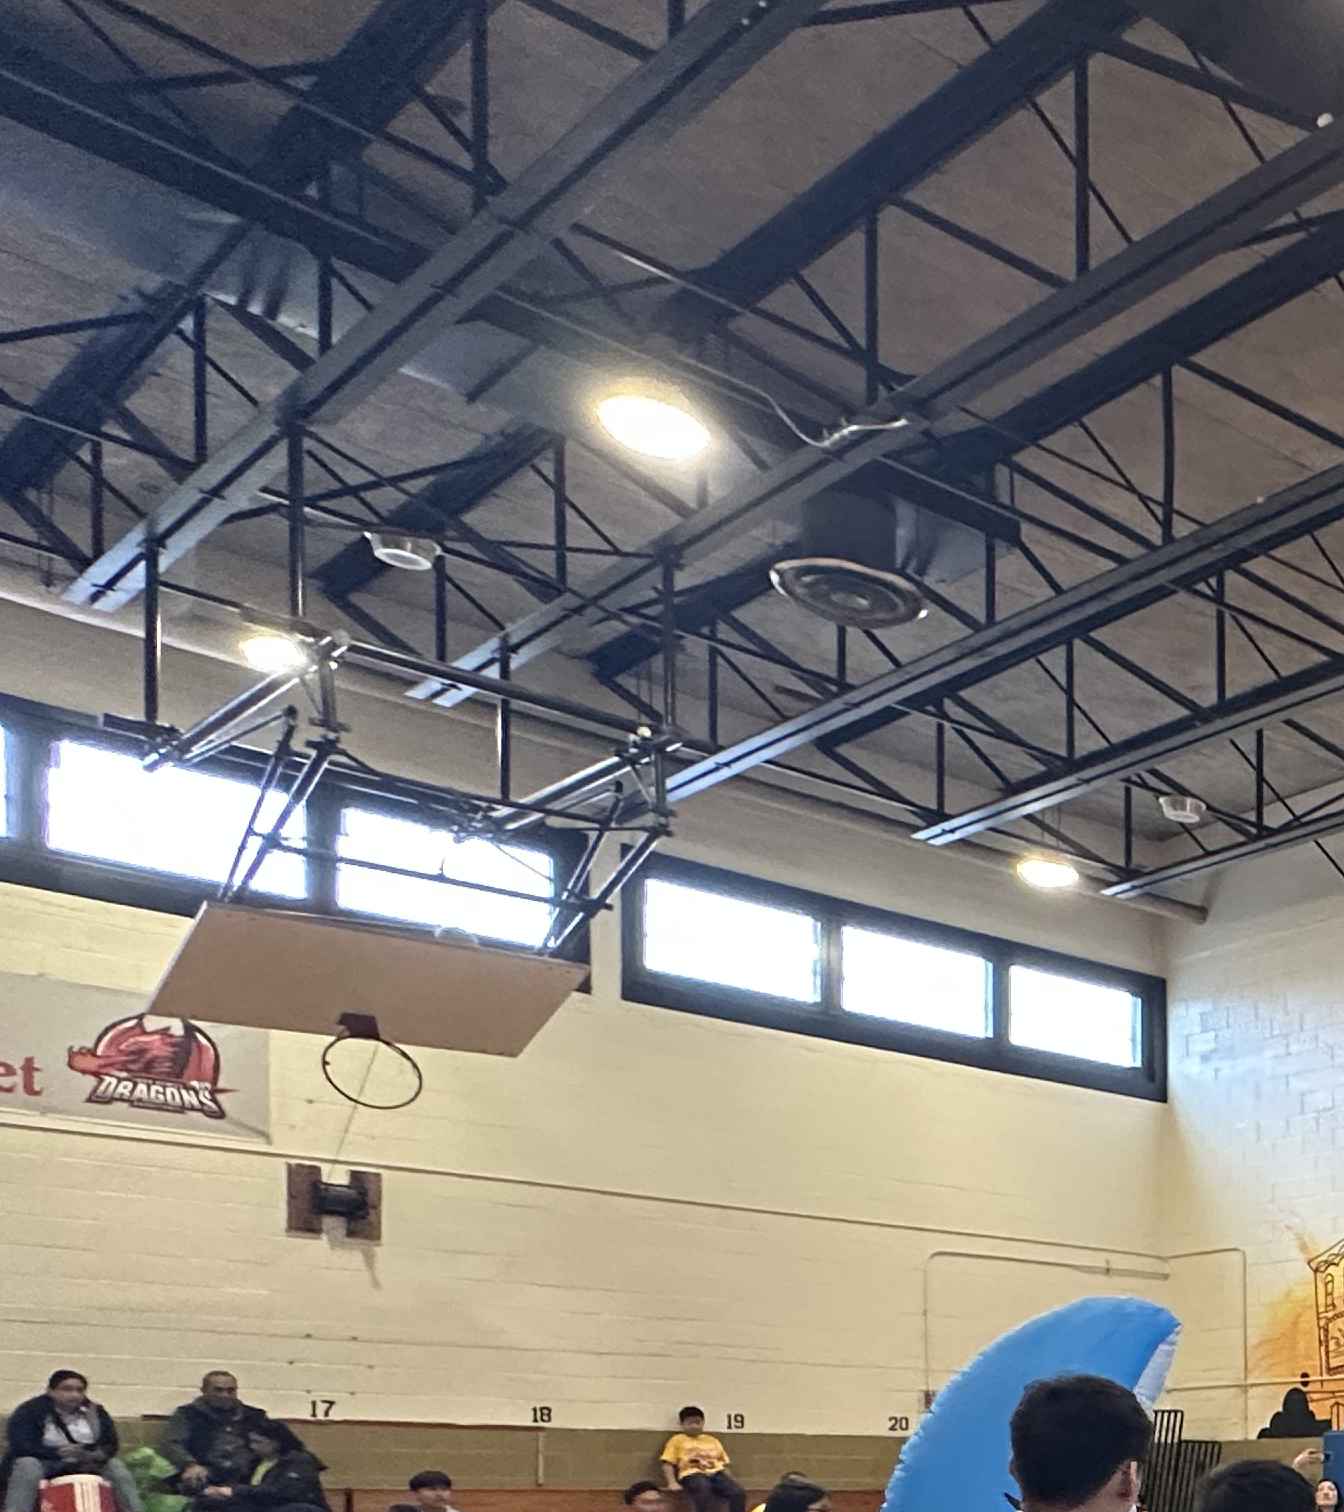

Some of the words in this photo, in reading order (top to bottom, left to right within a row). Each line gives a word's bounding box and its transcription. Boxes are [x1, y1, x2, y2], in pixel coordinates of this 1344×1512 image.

[92, 1074, 224, 1117] DRAGONS
[309, 1400, 336, 1418] 17
[531, 1406, 553, 1424] 18
[726, 1413, 745, 1430] 19
[888, 1416, 910, 1432] 20
